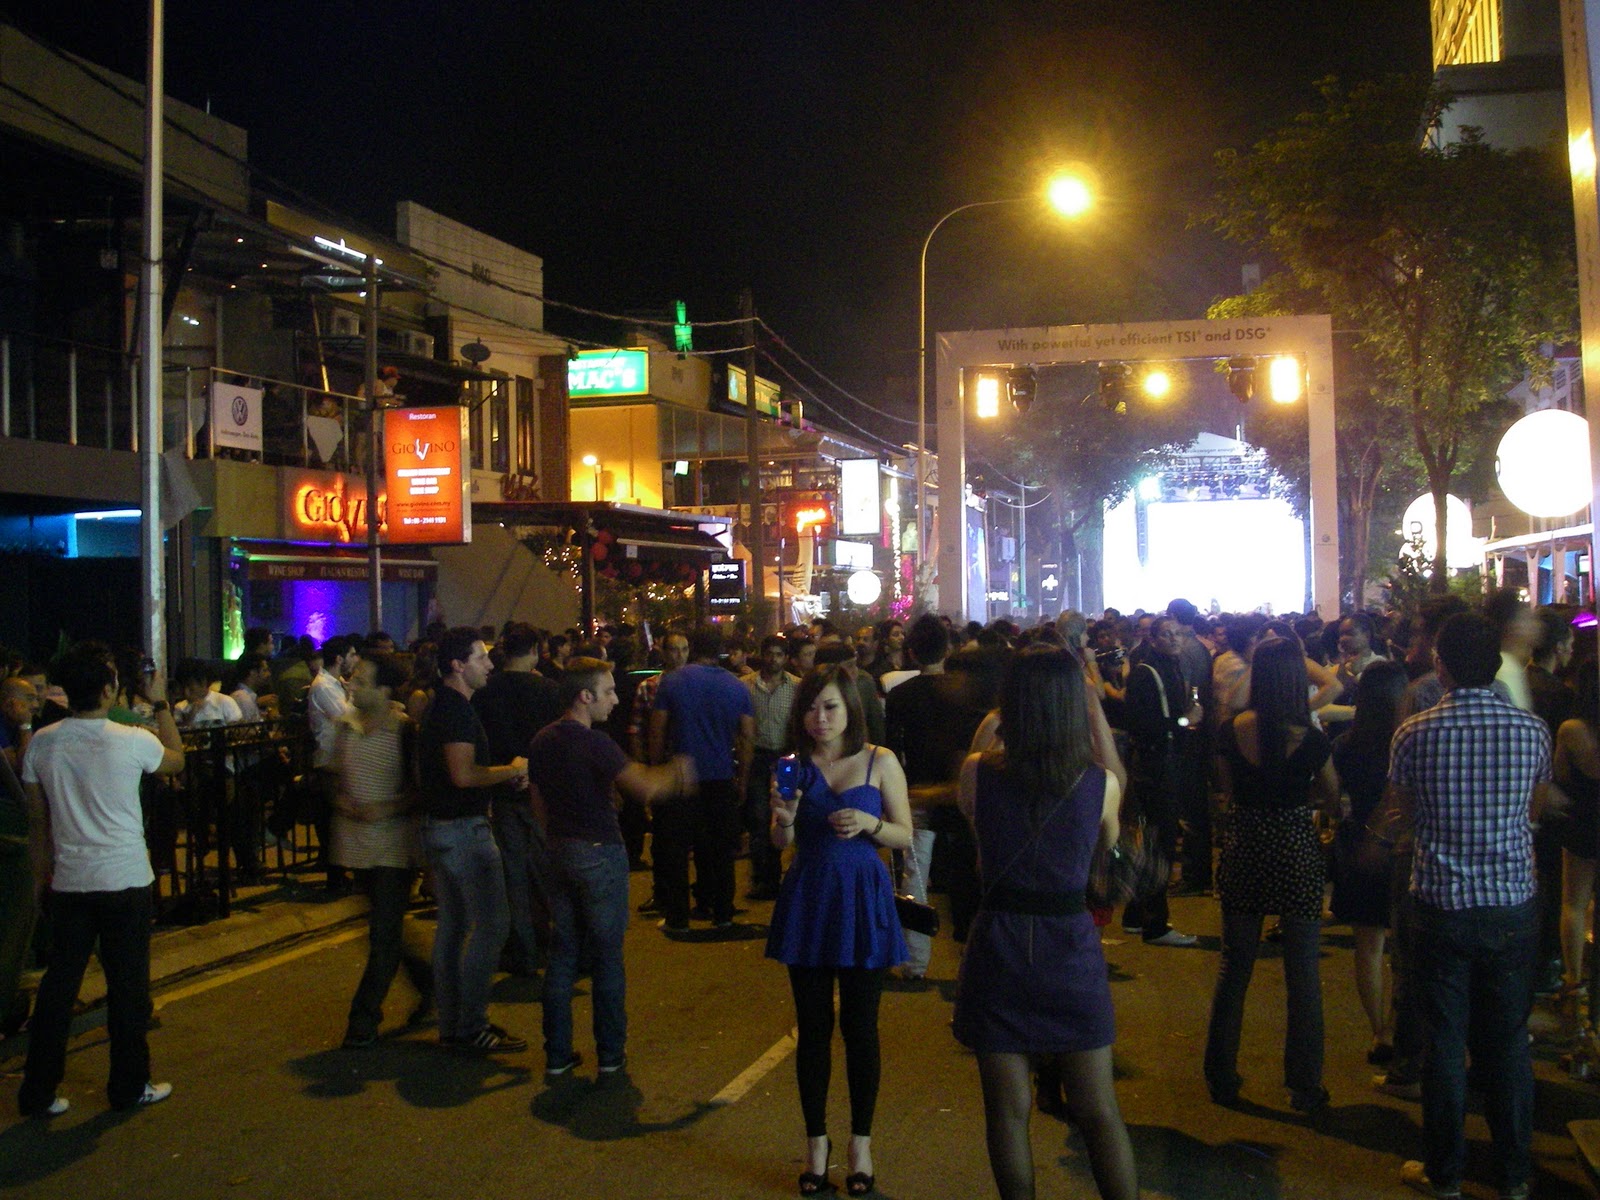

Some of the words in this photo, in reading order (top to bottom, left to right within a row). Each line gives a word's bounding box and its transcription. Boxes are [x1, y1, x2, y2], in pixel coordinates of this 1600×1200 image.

[998, 339, 1028, 351] With
[1032, 336, 1091, 352] powerful
[1096, 337, 1116, 350] yet
[1120, 332, 1172, 346] efficient
[1205, 328, 1231, 341] and
[408, 412, 437, 420] Restoran
